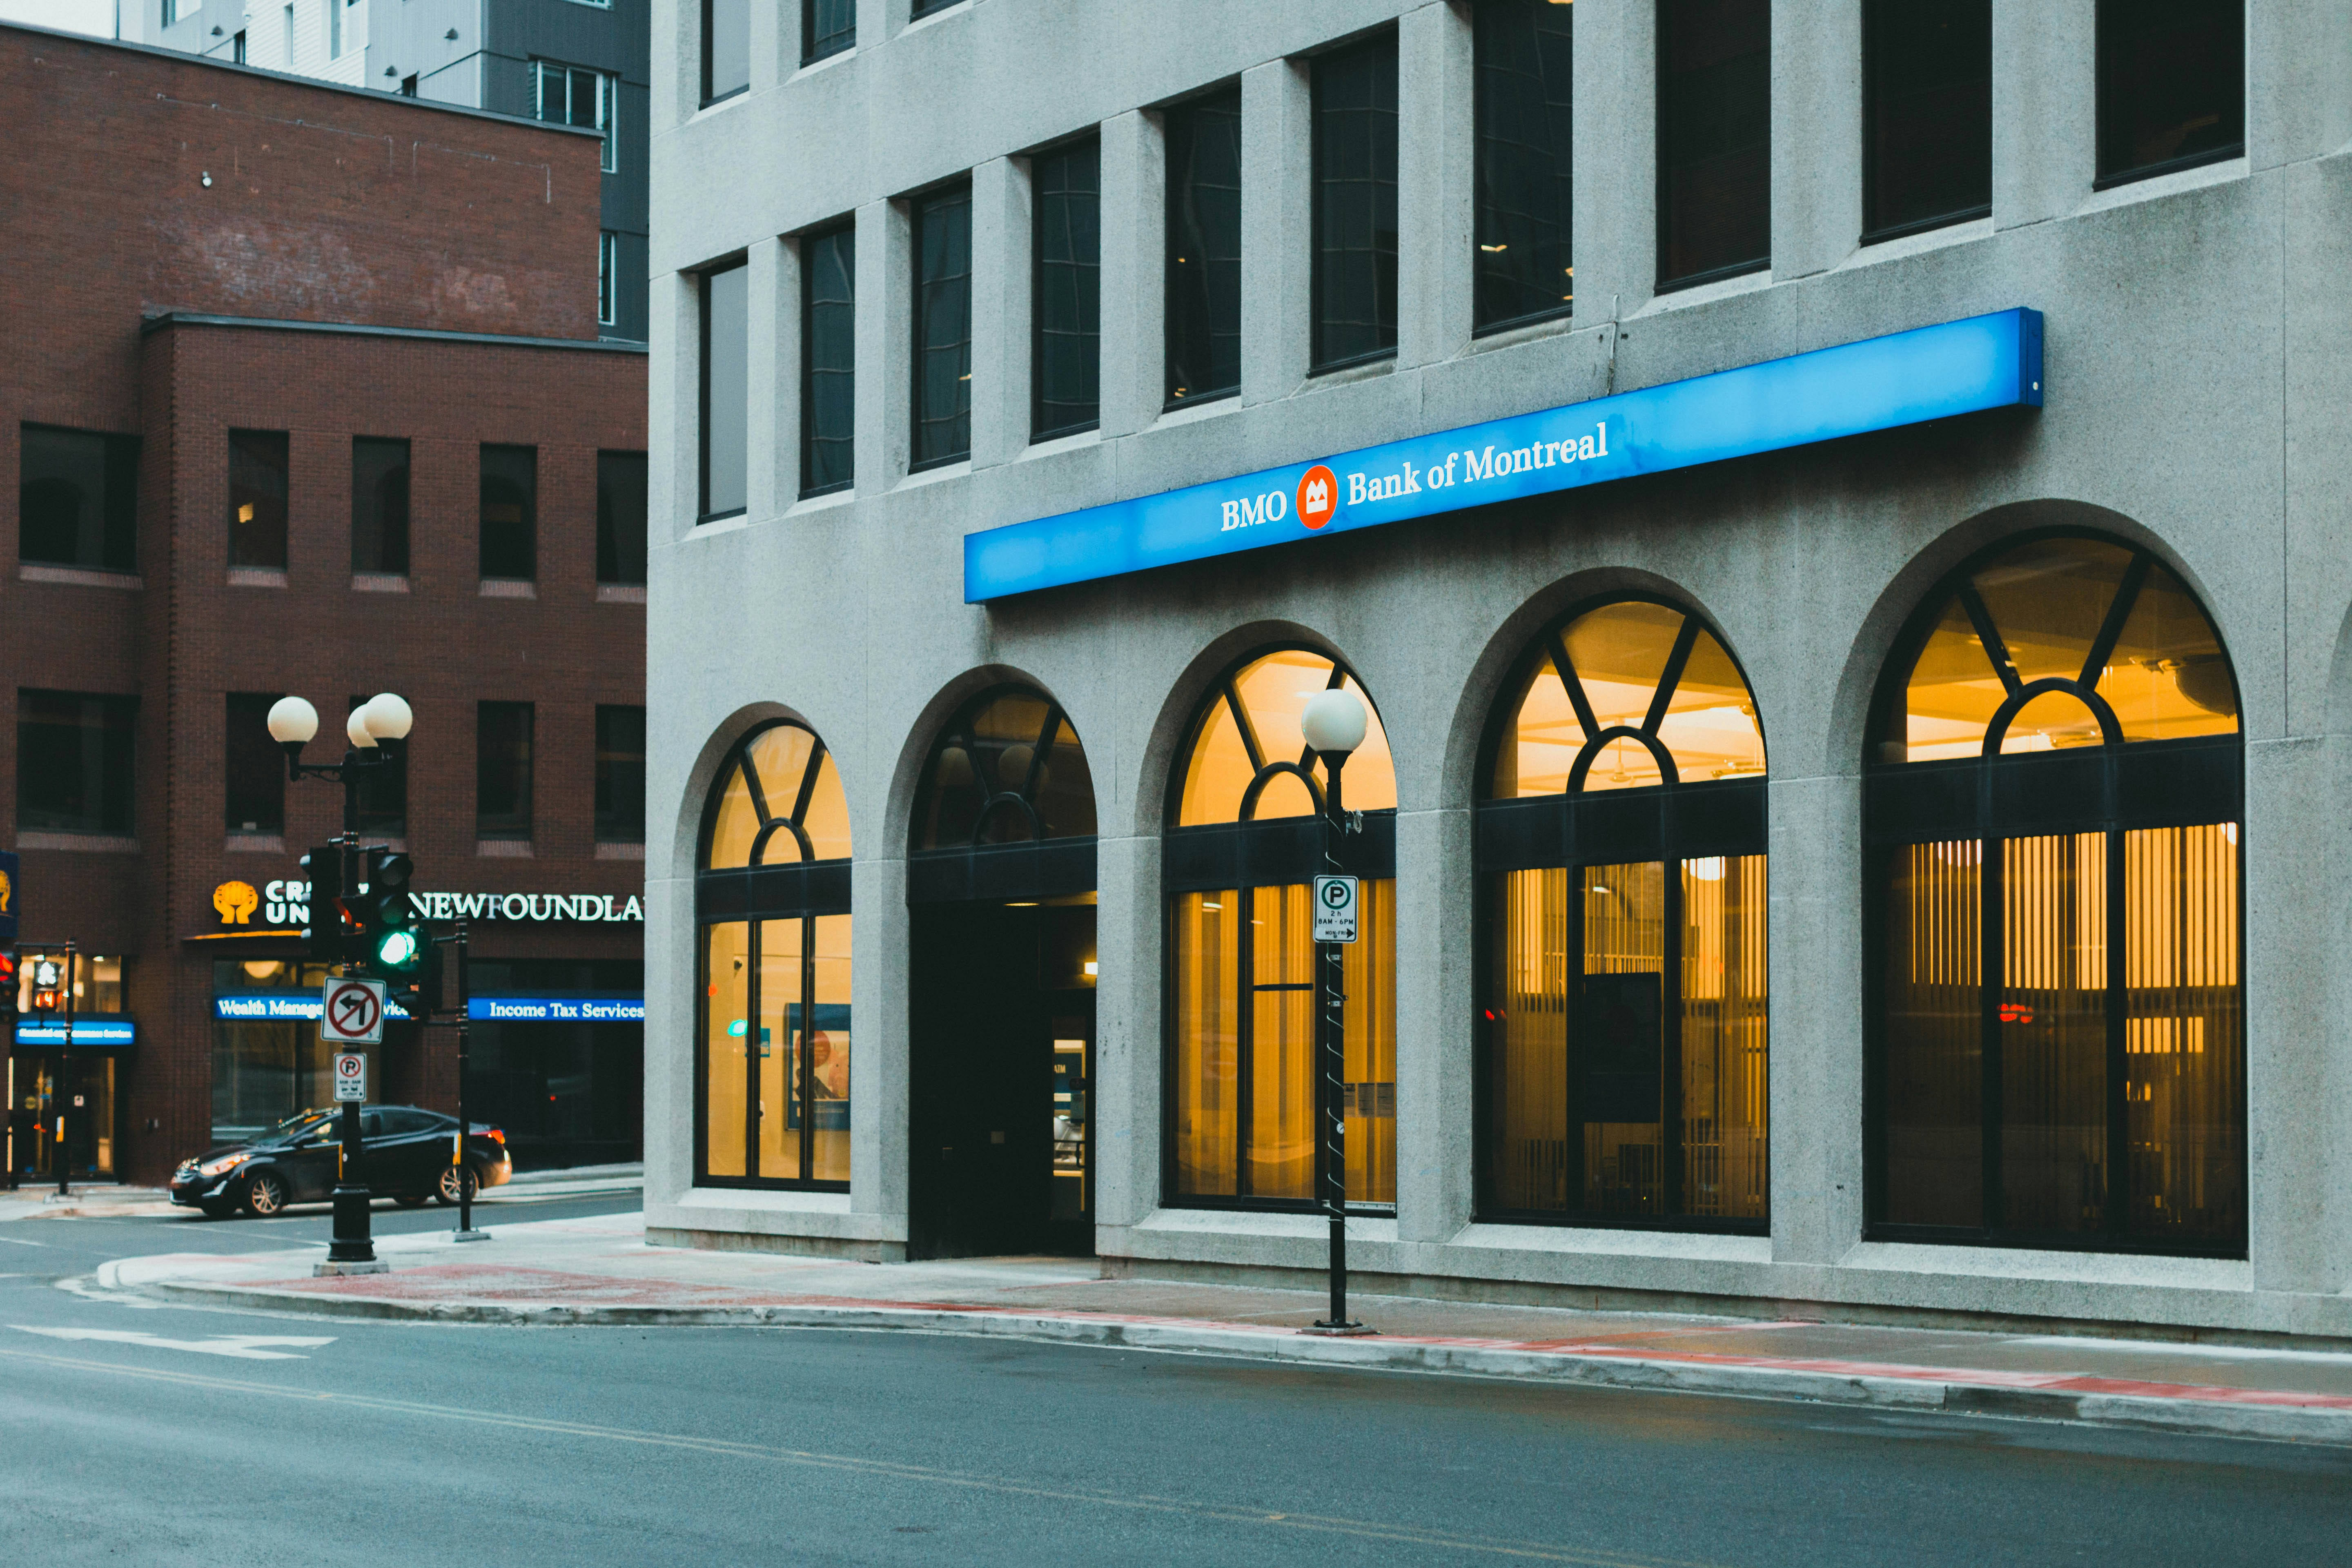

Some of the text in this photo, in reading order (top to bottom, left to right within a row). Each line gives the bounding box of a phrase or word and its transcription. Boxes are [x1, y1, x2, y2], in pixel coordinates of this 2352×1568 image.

[1221, 421, 1608, 532] BMO Bank of Montreal
[265, 880, 312, 902] CR
[1330, 886, 1344, 903] P
[408, 892, 645, 921] NEWFOUNDLA
[218, 1000, 266, 1015] Wealth
[269, 1000, 324, 1019] Manage
[490, 1002, 644, 1018] Income Tax Services
[1054, 1065, 1065, 1073] ATM
